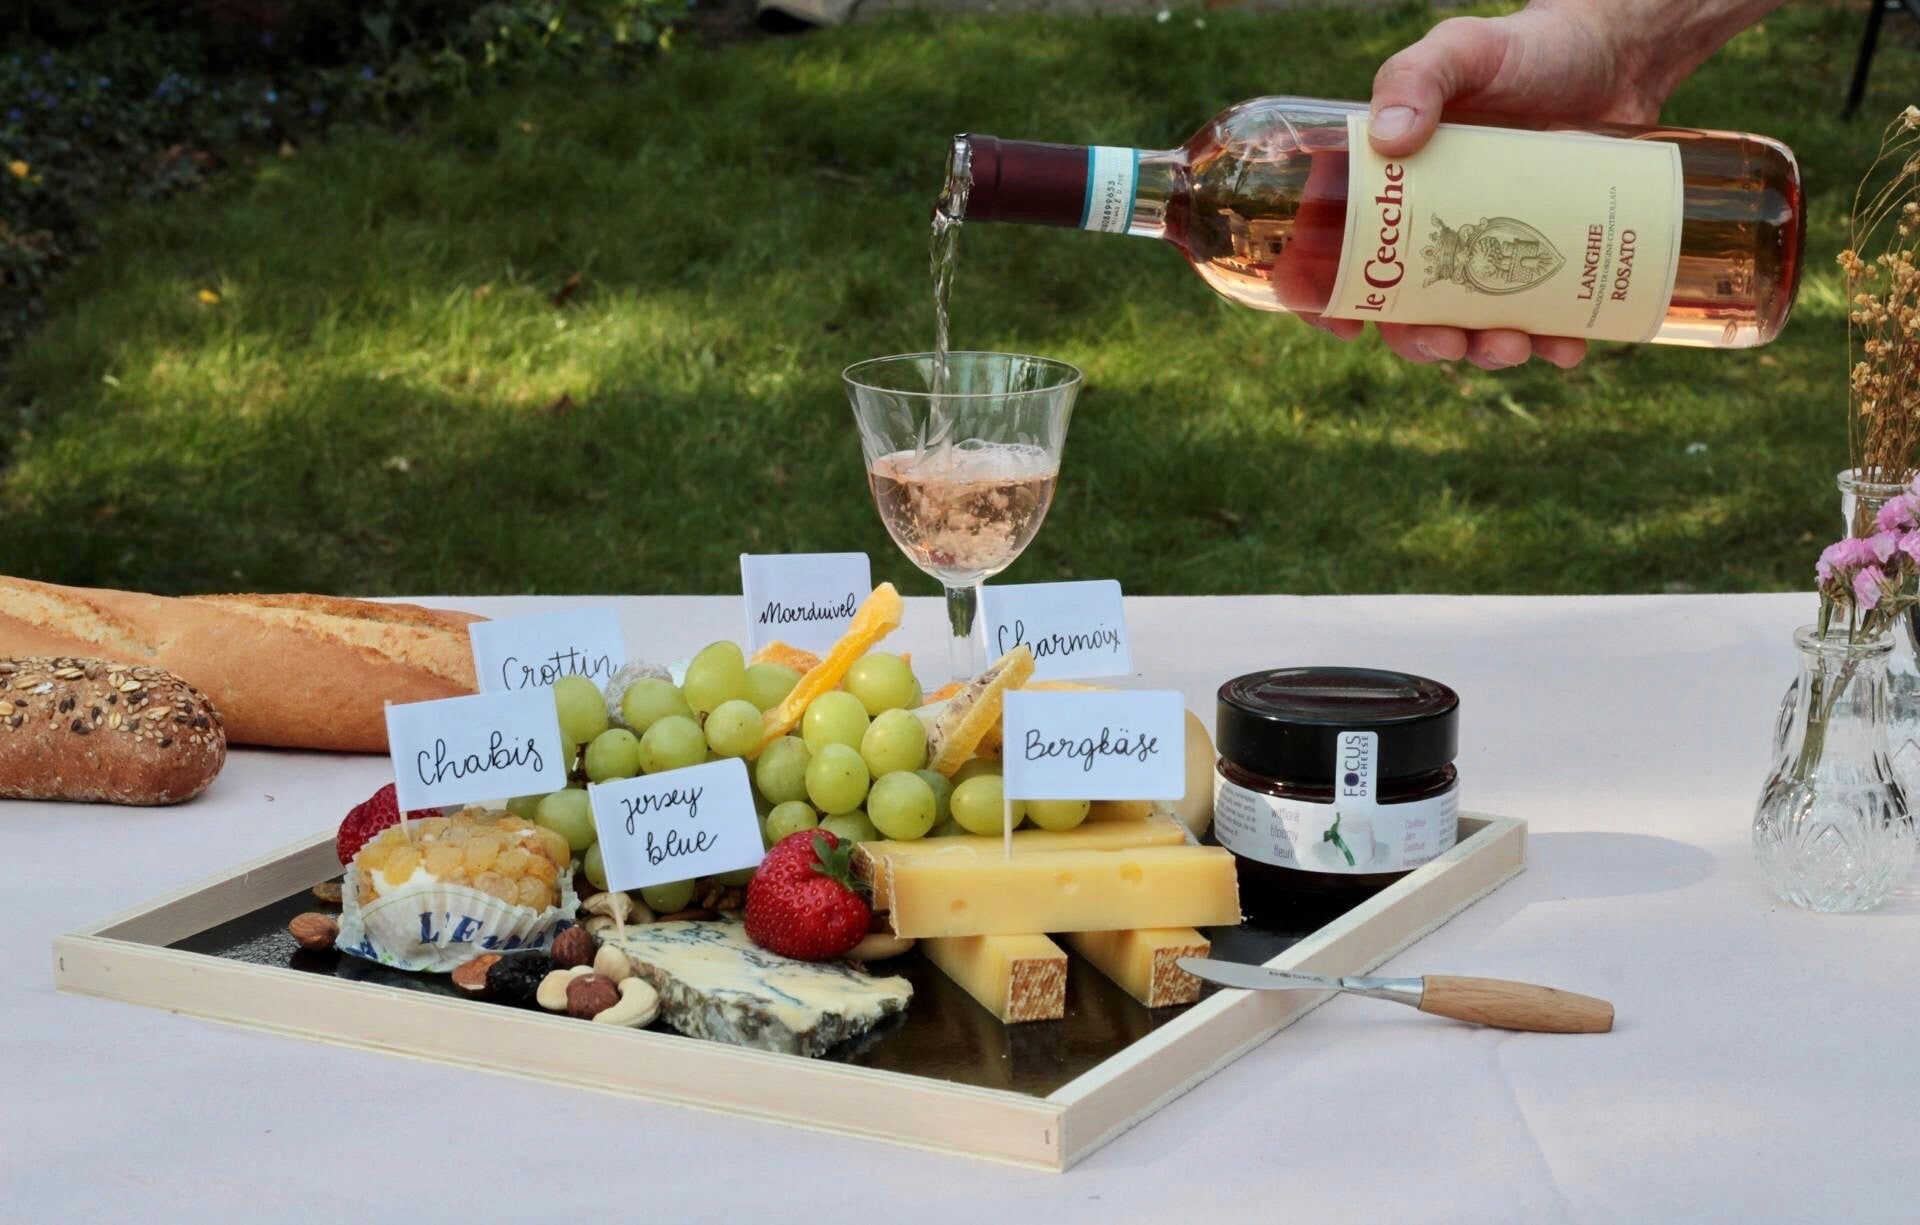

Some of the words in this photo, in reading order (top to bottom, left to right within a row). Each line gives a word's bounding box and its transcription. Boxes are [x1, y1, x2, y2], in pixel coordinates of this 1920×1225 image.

[1364, 163, 1405, 289] Cecche
[1577, 223, 1604, 300] LANGHE
[1610, 229, 1637, 301] ROSATO
[1355, 293, 1386, 312] le
[502, 646, 618, 690] Crottin
[417, 730, 544, 785] Chabis
[1025, 727, 1159, 772] Bergkäse
[1343, 735, 1361, 797] FOCUS
[1360, 735, 1369, 777] CHEESE
[1360, 781, 1367, 797] ON
[645, 829, 719, 866] blue
